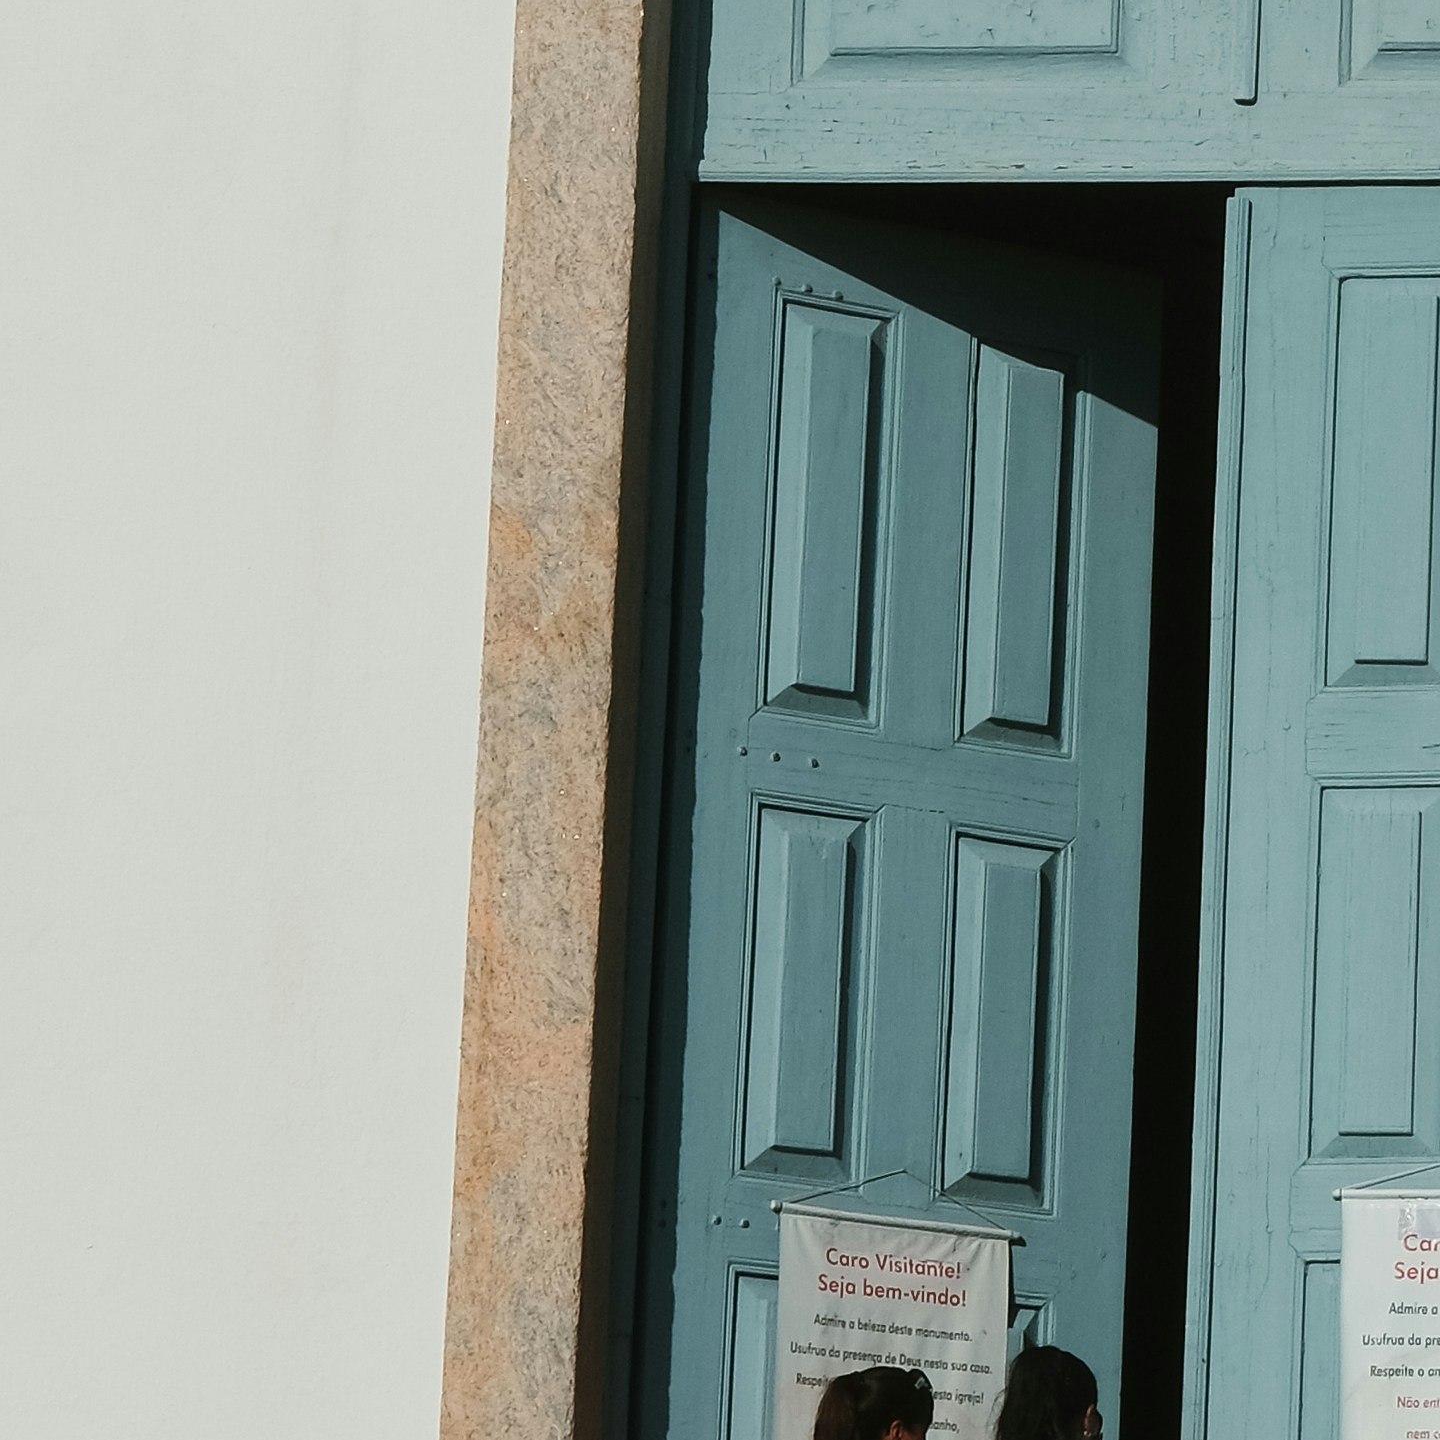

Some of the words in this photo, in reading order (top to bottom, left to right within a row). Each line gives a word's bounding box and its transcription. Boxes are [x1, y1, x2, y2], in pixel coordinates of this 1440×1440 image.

[826, 1248, 869, 1269] Caro
[876, 1254, 960, 1279] Visitante!
[1394, 1262, 1439, 1284] Seja
[818, 1274, 856, 1298] Seja
[864, 1279, 966, 1307] bem-vindo!
[1389, 1302, 1428, 1315] Admire
[1431, 1306, 1438, 1315] a
[814, 1314, 846, 1328] Admire
[858, 1318, 886, 1333] beleza
[888, 1322, 912, 1335] deste
[916, 1328, 972, 1342] monumento.
[1362, 1333, 1404, 1346] Usufrua
[1408, 1333, 1421, 1346] da
[790, 1341, 826, 1357] Usufrua
[829, 1346, 840, 1358] da
[843, 1350, 882, 1365] presença
[885, 1352, 896, 1365] de
[900, 1354, 921, 1367] Deus
[924, 1359, 948, 1370] nesta
[951, 1362, 967, 1371] sua
[970, 1364, 992, 1374] casa.
[1370, 1364, 1414, 1379] Respeite
[1418, 1368, 1424, 1376] o
[796, 1373, 828, 1388] Respei
[933, 1390, 952, 1400] esta
[955, 1388, 984, 1406] igreja!
[1397, 1396, 1419, 1408] Não
[1407, 1431, 1429, 1439] nem
